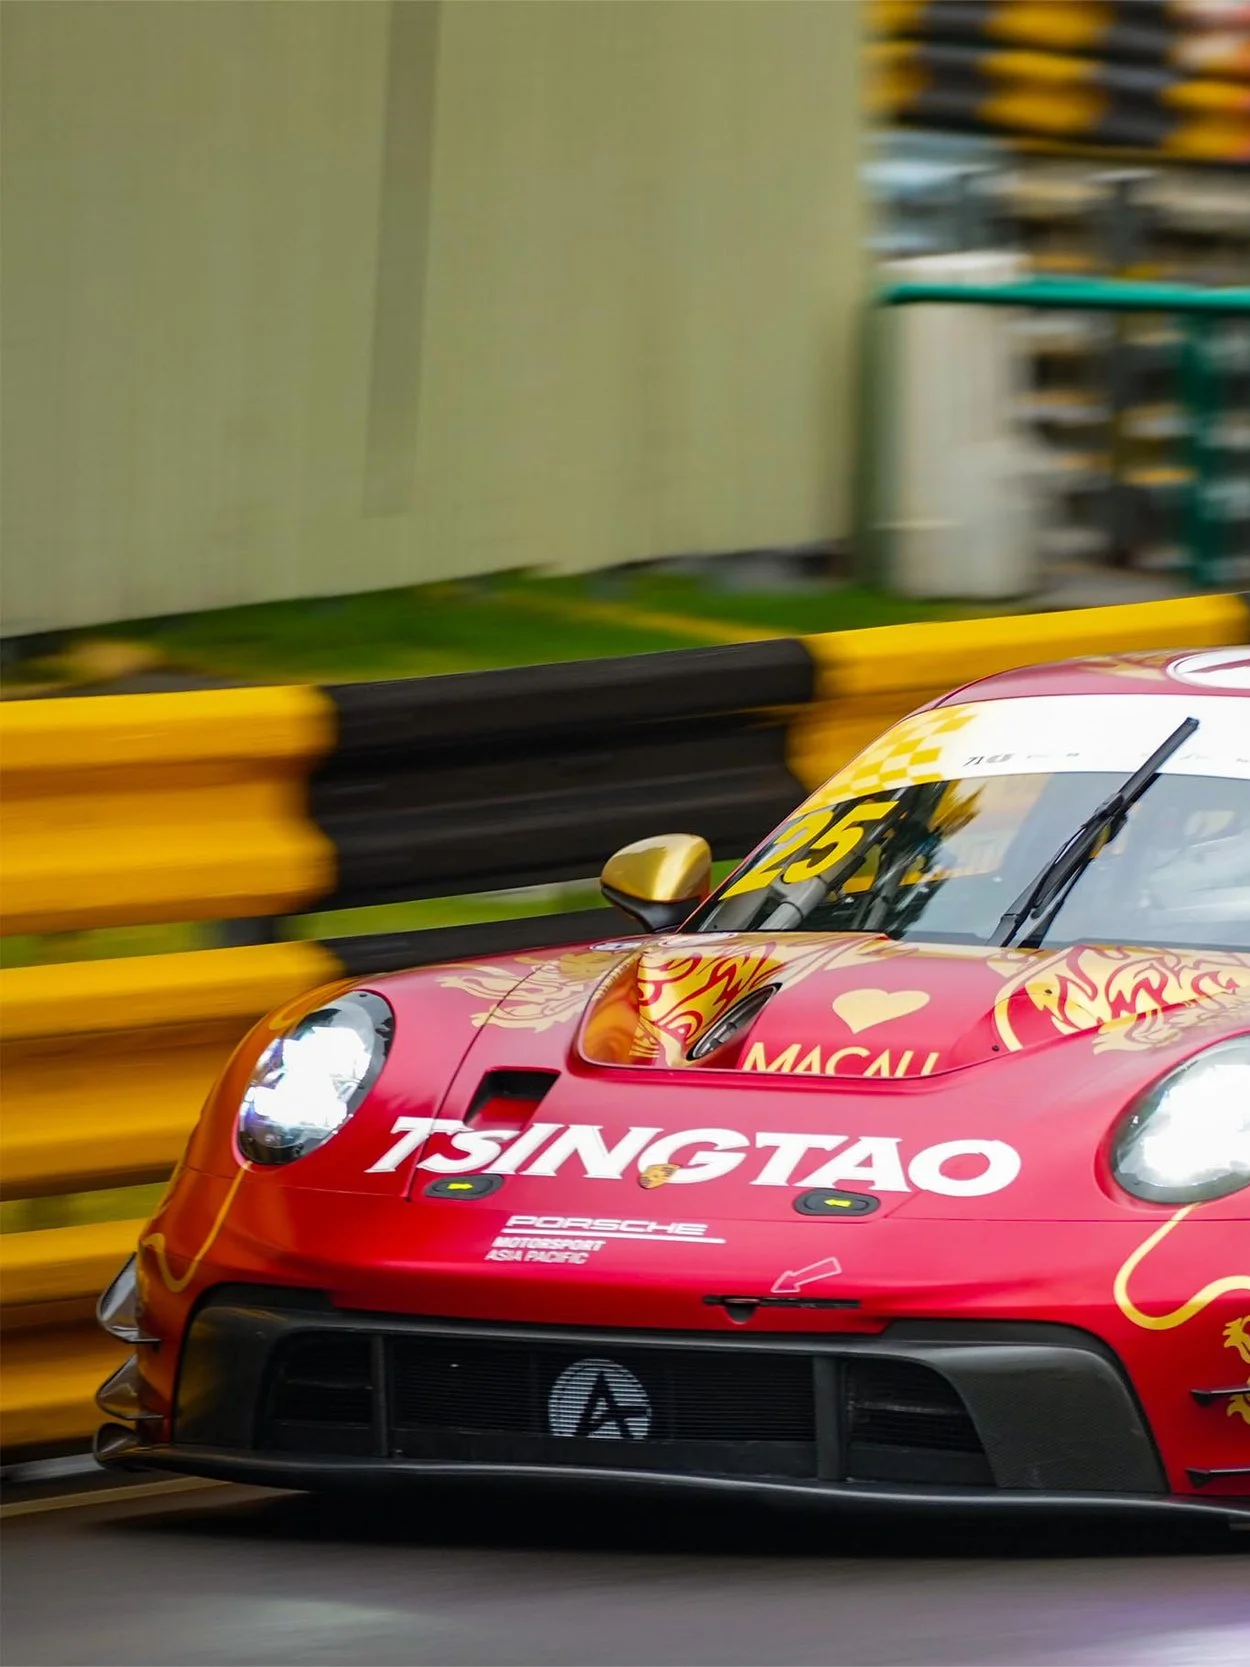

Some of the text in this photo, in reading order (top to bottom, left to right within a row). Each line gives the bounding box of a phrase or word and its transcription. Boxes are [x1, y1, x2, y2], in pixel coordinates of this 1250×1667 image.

[719, 801, 900, 899] 25
[365, 1115, 1021, 1197] TSINGTAO
[505, 1215, 708, 1236] PORSCHE
[491, 1236, 606, 1252] MOTORSPORT
[484, 1249, 590, 1264] ASIA PACIFIC
